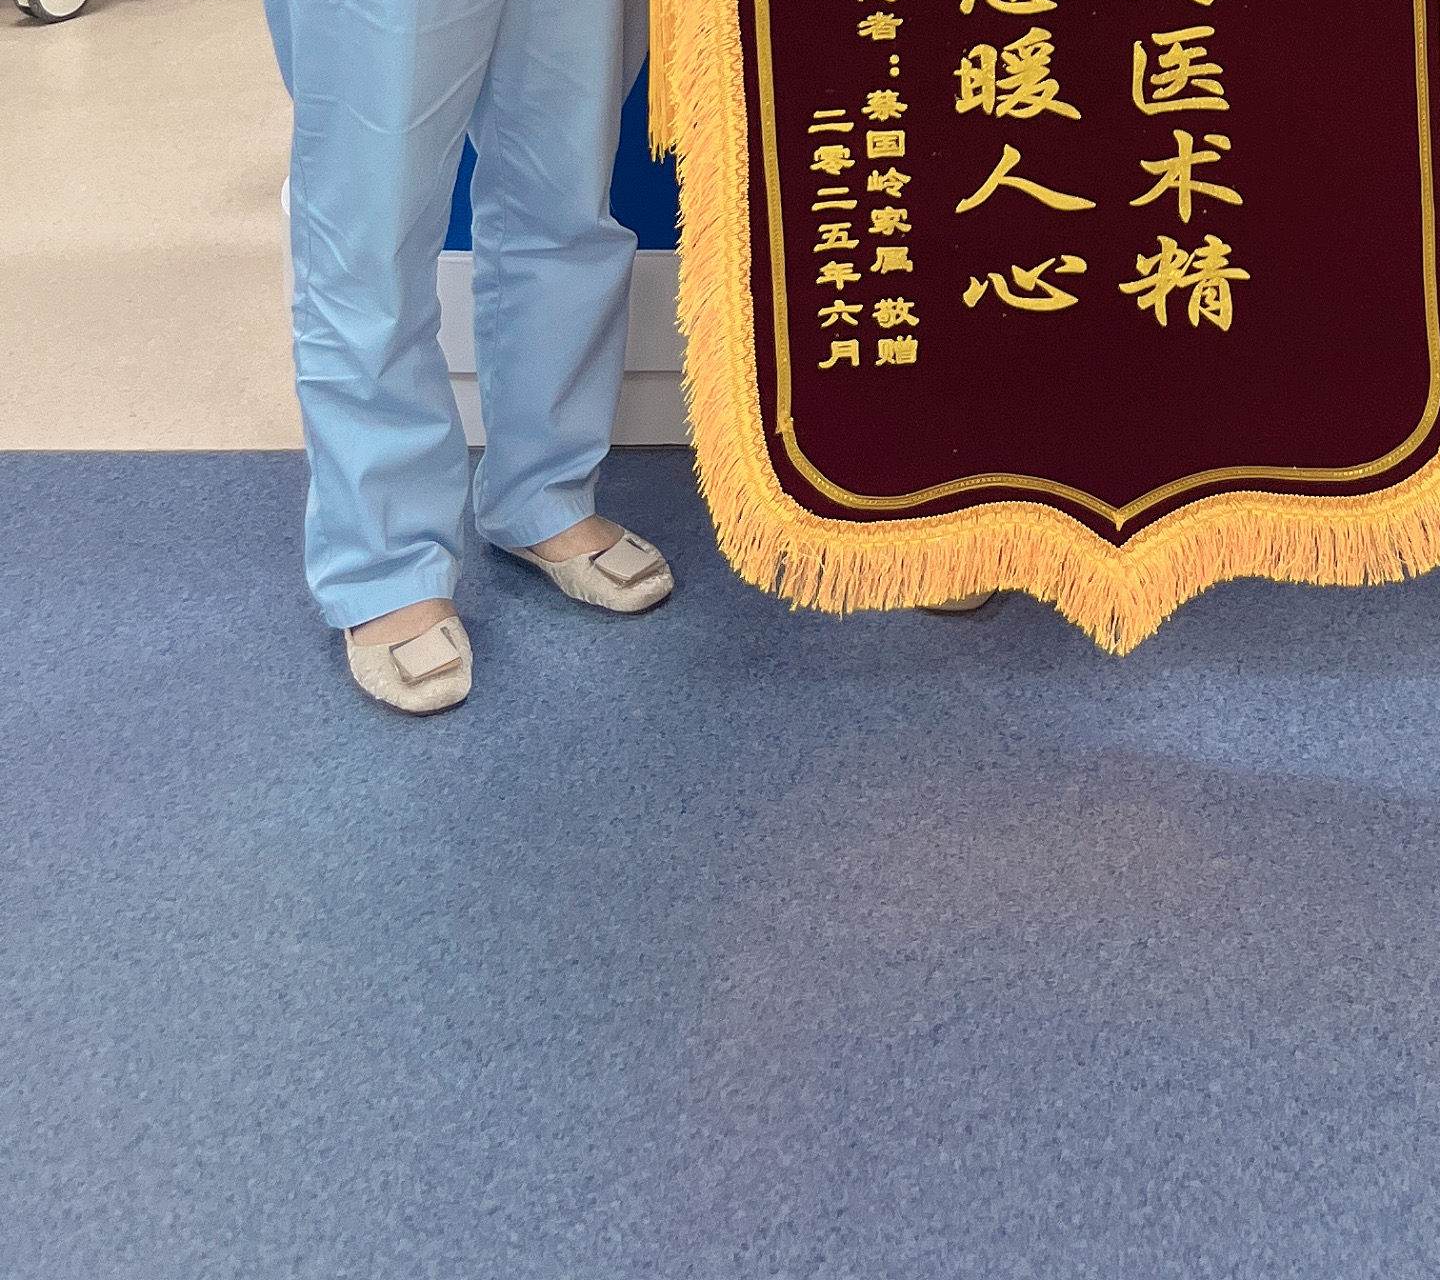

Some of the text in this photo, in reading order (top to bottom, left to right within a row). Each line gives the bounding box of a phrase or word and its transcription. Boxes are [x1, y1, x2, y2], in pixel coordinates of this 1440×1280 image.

[807, 109, 864, 370] 二零二五年六月
